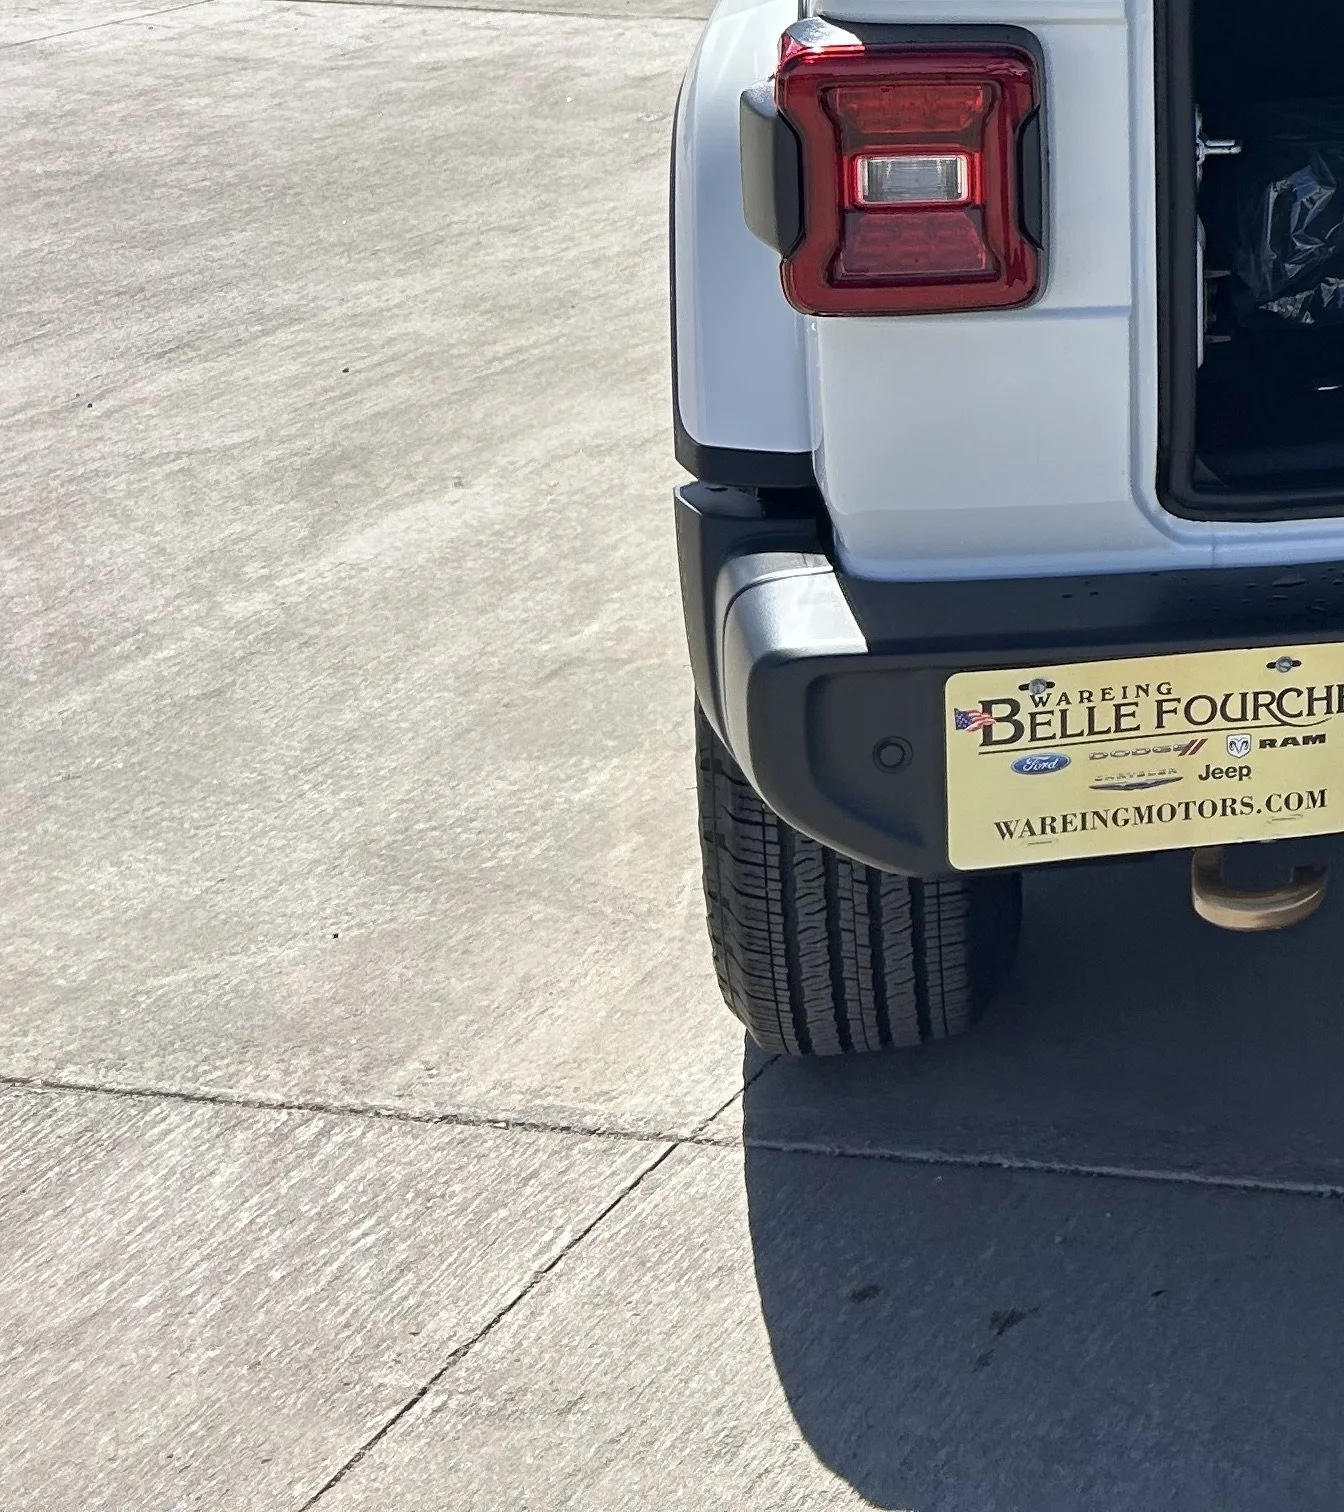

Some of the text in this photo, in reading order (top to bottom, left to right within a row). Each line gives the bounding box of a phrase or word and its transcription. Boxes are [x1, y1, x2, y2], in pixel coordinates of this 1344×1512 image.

[1029, 681, 1173, 708] WAREING
[978, 697, 1141, 747] BELLE
[1089, 743, 1188, 761] DODGE
[1258, 733, 1327, 749] RAM
[1198, 764, 1252, 781] Jeep
[993, 788, 1328, 840] WAREINGMOTORS.COM
